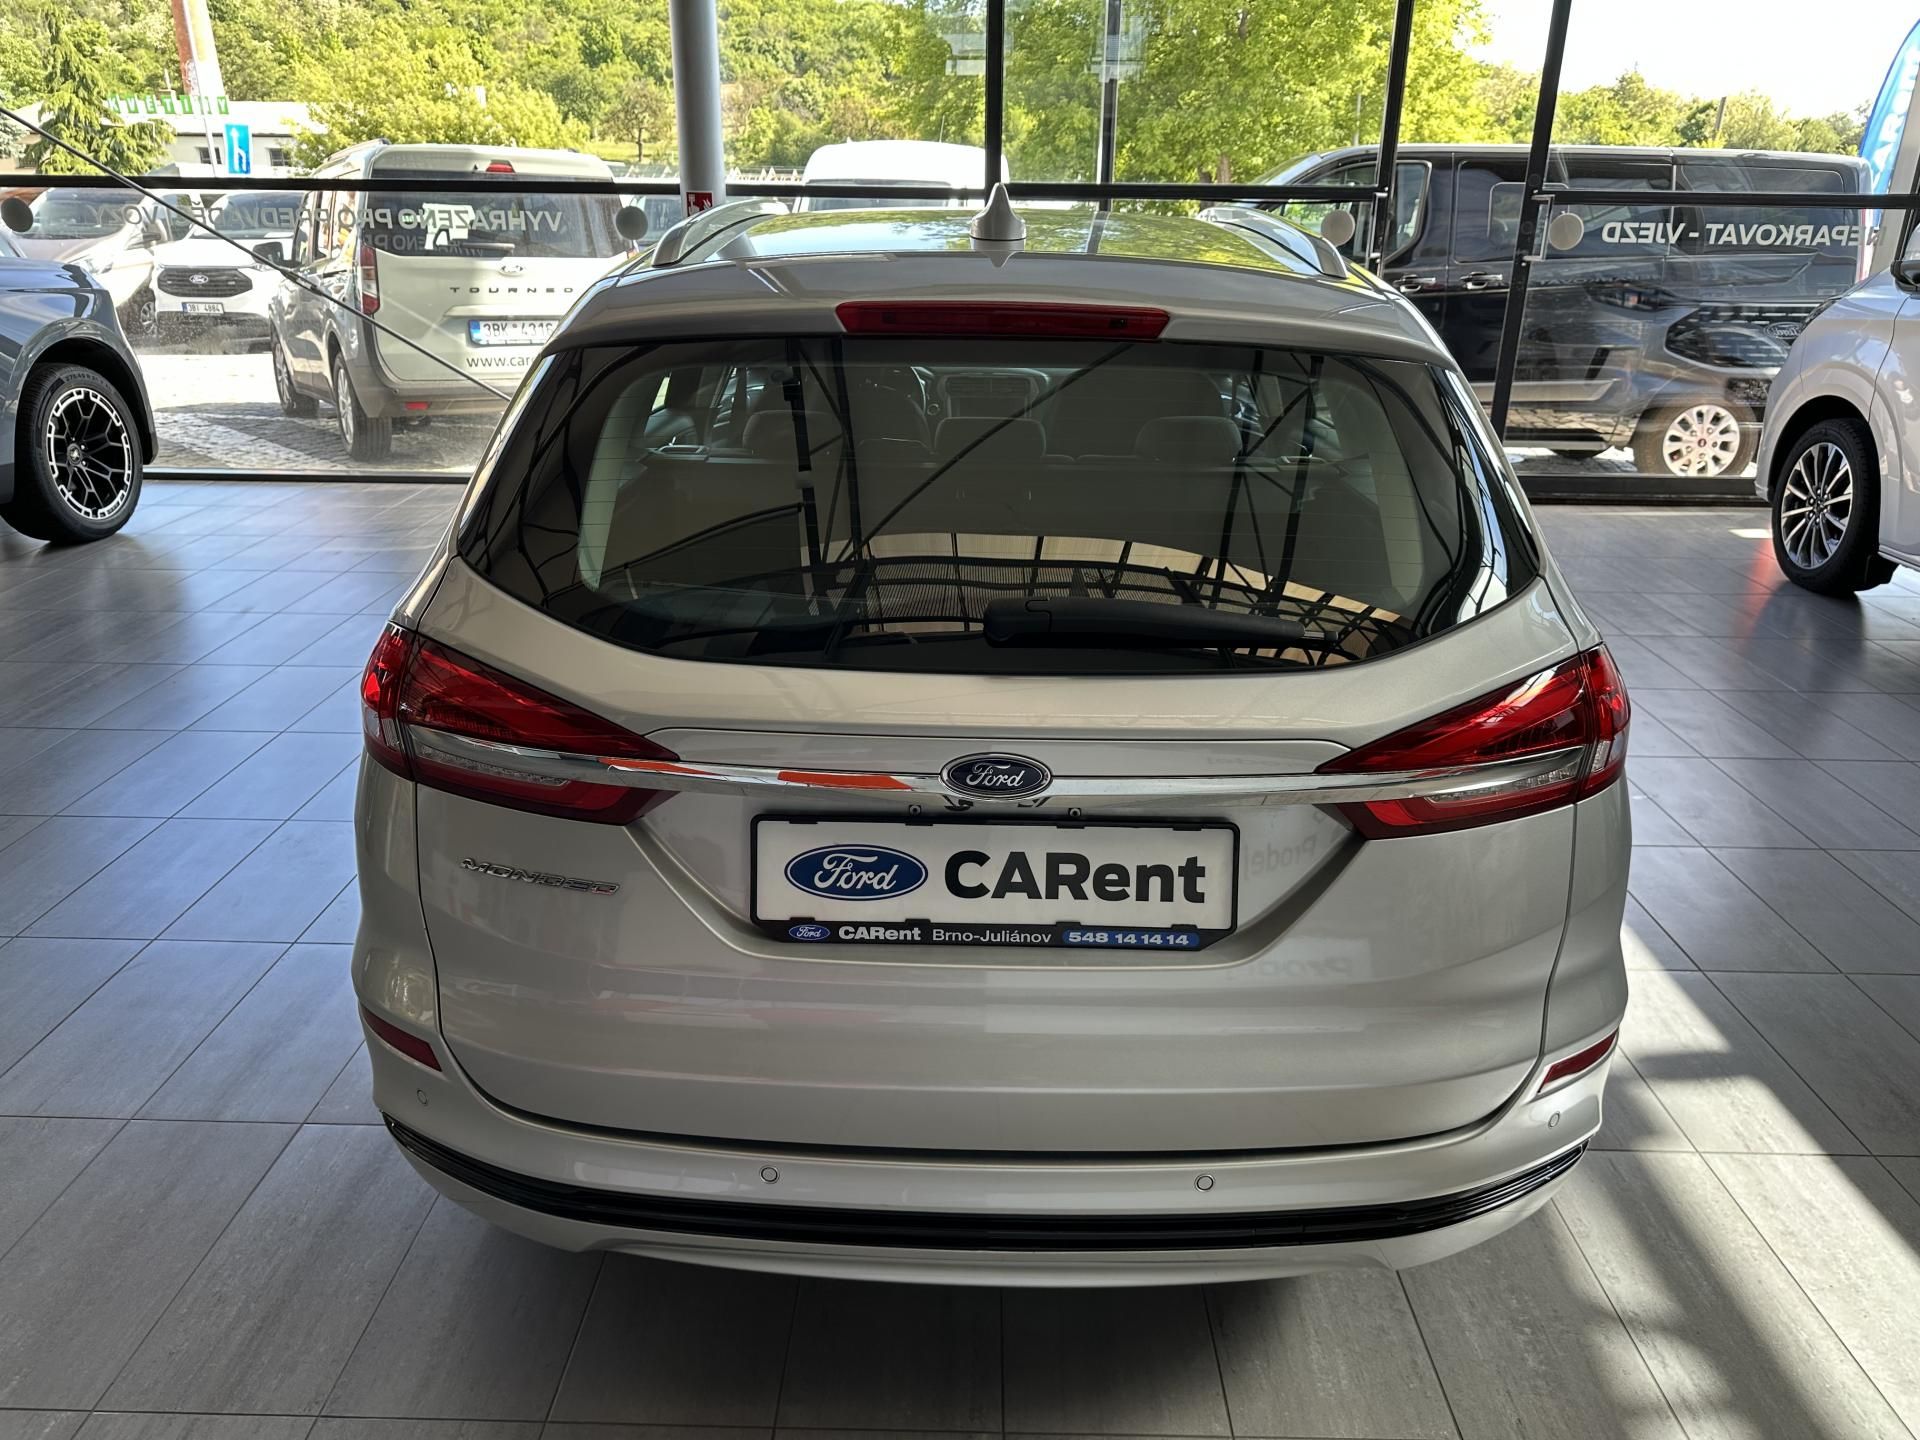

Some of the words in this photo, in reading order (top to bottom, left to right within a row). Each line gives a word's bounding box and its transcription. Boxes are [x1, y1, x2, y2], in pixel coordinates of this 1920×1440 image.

[449, 286, 574, 294] TOURNEO
[483, 322, 509, 337] 3BK
[965, 762, 1027, 787] Ford
[460, 857, 621, 896] MONDEO
[812, 853, 899, 889] Ford
[944, 849, 1206, 904] CARent
[796, 926, 822, 938] Ford
[838, 925, 921, 941] CARent
[932, 928, 1052, 943] Brno-Juliánov
[1068, 931, 1109, 943] 548
[1115, 932, 1137, 944] 14
[1141, 933, 1163, 945] 14
[1167, 934, 1190, 946] 14
